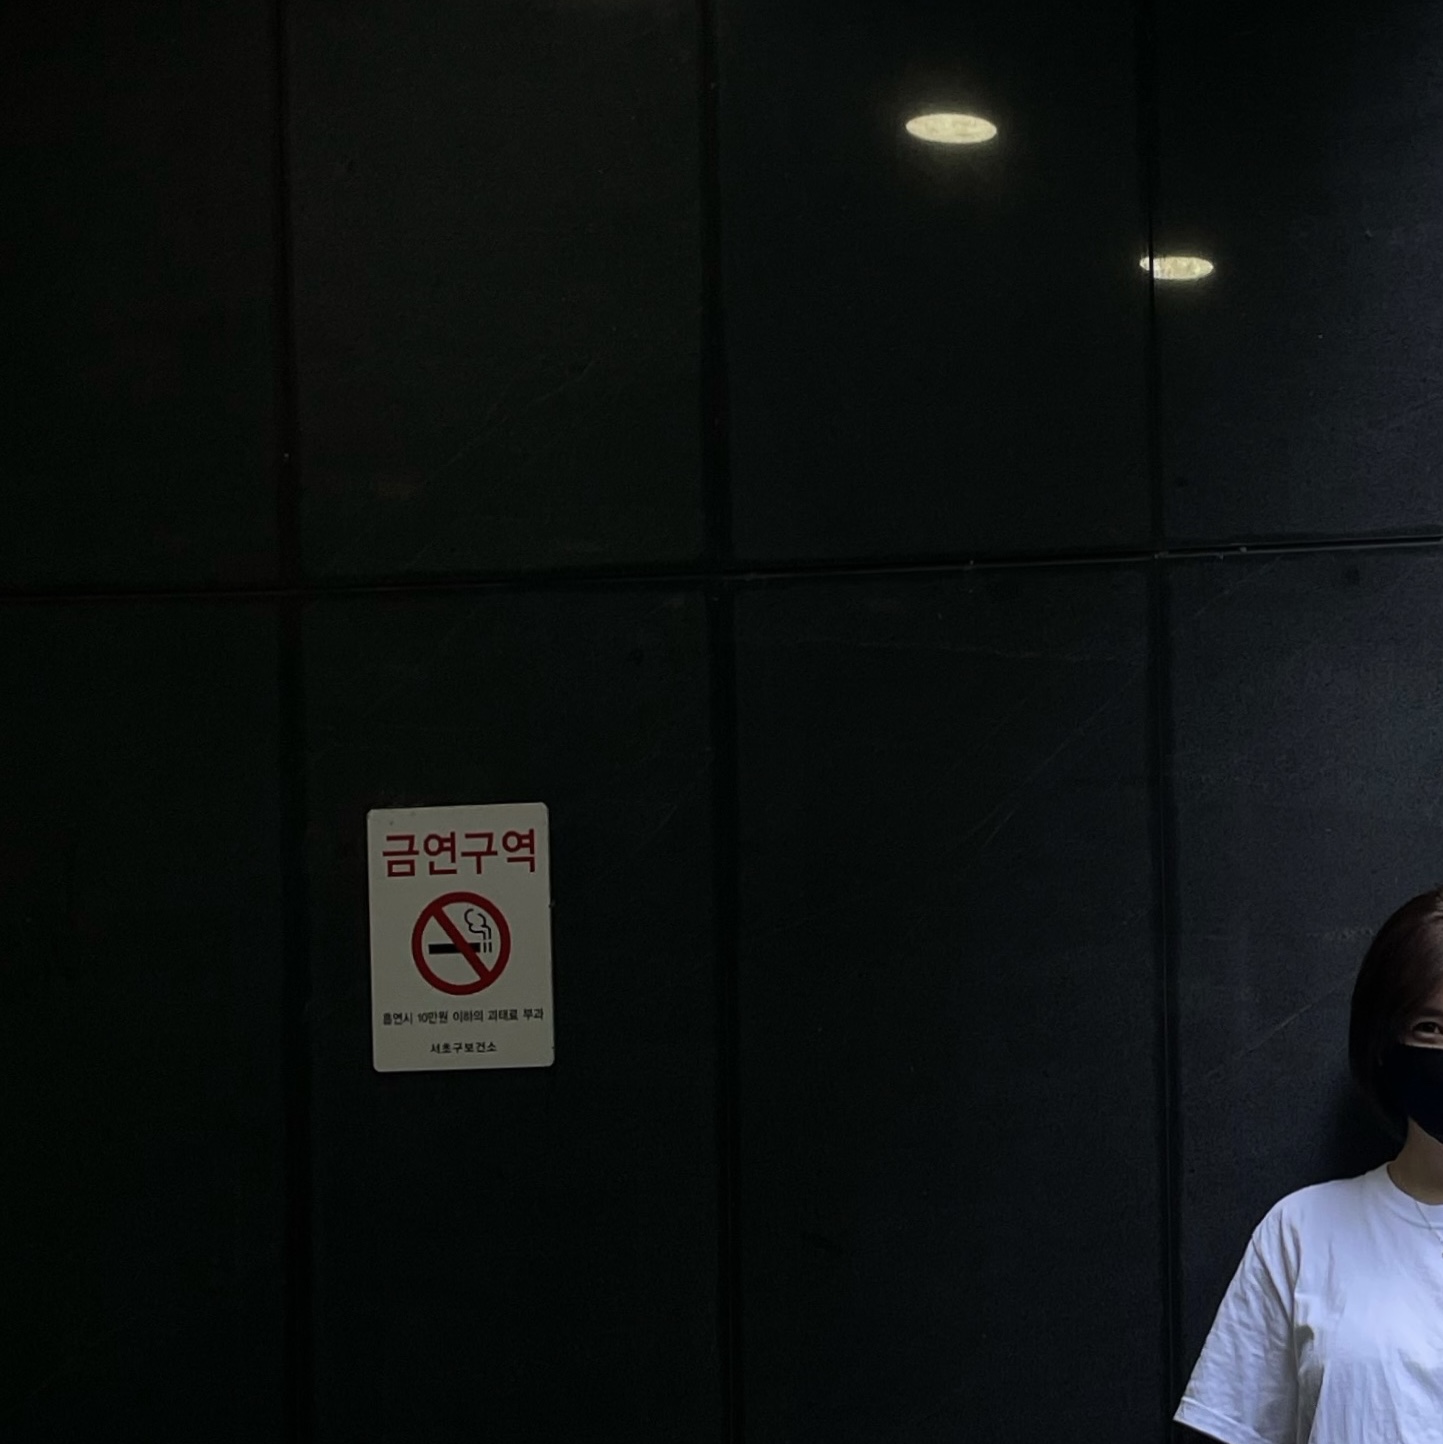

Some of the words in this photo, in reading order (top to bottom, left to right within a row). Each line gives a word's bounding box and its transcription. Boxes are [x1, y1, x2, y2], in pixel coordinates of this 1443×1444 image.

[382, 828, 536, 878] 금연구역
[417, 1010, 449, 1025] 10만원
[452, 1009, 484, 1023] 이하의
[523, 1007, 545, 1021] 부과
[430, 1041, 498, 1055] 서초구보건소
